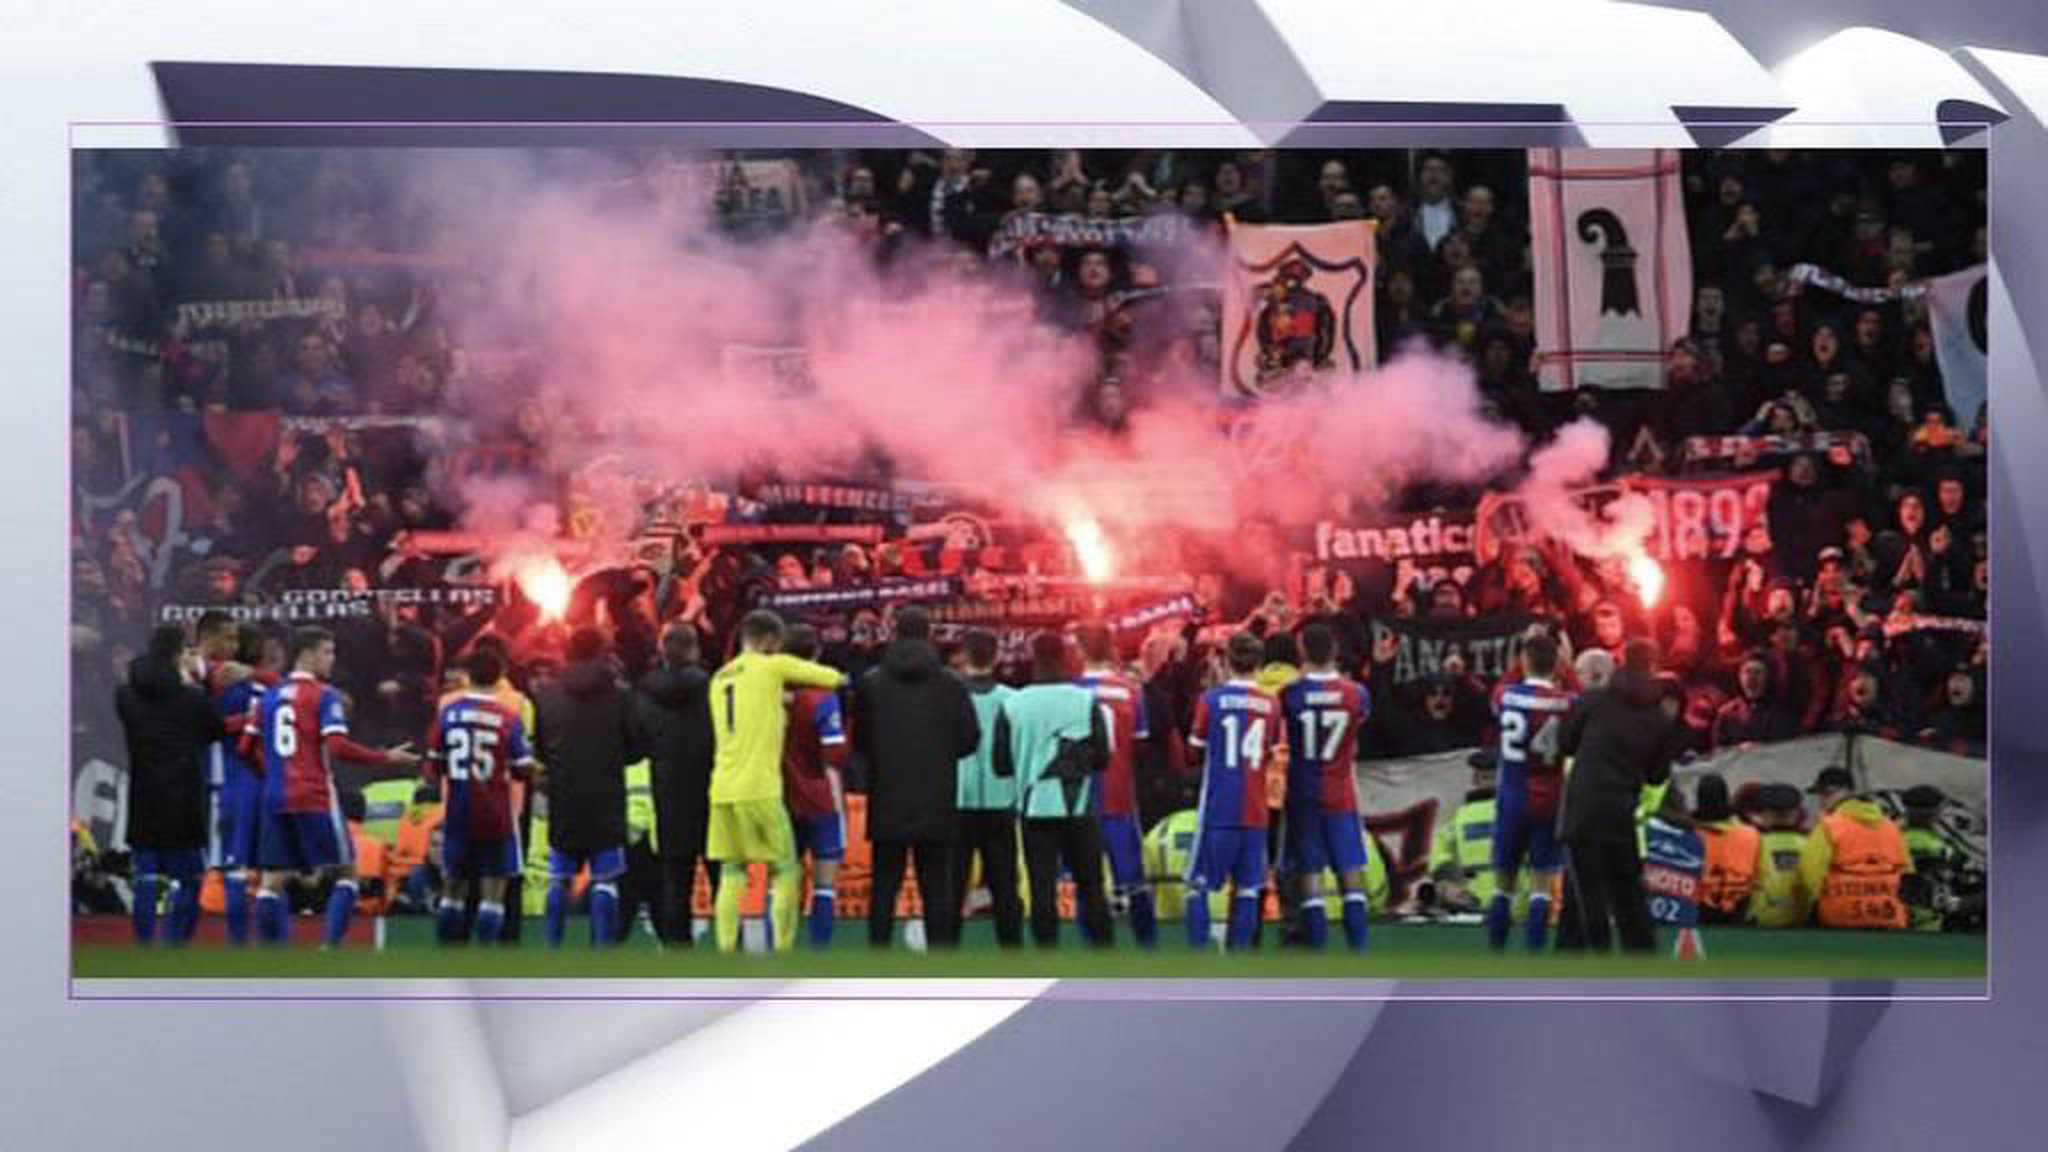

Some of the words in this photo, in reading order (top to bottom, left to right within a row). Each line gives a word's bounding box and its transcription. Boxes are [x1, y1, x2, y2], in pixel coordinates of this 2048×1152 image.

[274, 704, 298, 757] 6
[724, 683, 735, 733] 1
[446, 727, 499, 781] 25
[1221, 714, 1267, 769] 14
[1298, 710, 1350, 761] 17
[1501, 710, 1557, 765] 24
